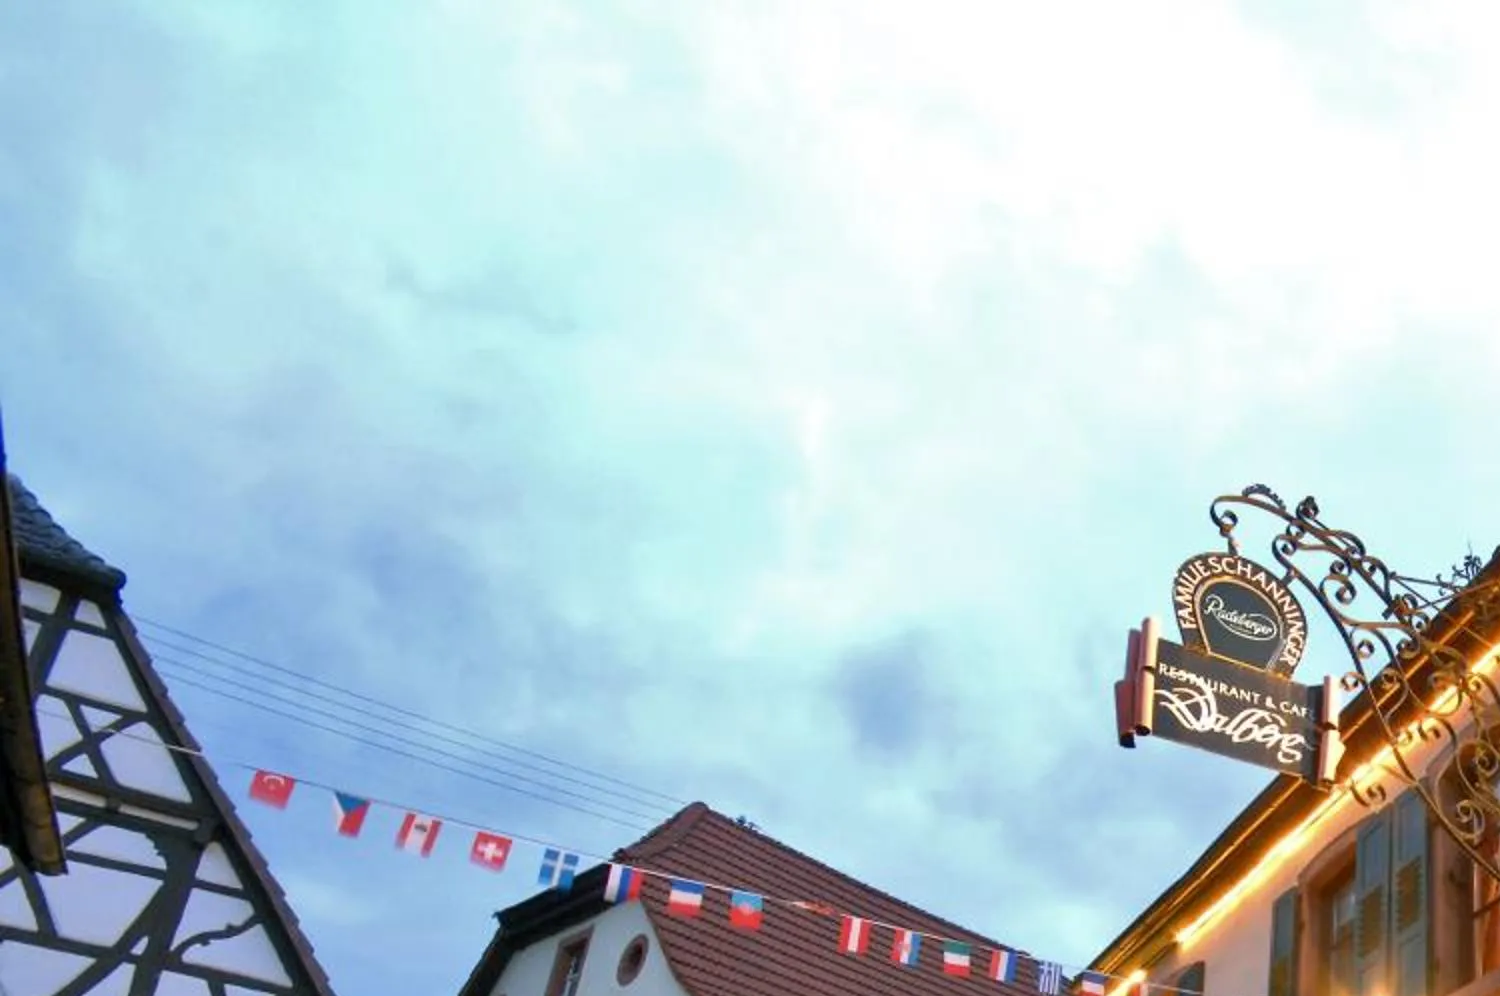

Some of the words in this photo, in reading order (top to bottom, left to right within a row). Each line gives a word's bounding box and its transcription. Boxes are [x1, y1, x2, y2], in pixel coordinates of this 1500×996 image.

[1176, 559, 1211, 630] FAMILIE
[1208, 556, 1304, 667] SCHANNINGER
[1154, 680, 1315, 763] Dalberg
[1159, 662, 1261, 705] RESTAURANT
[1265, 697, 1276, 709] &
